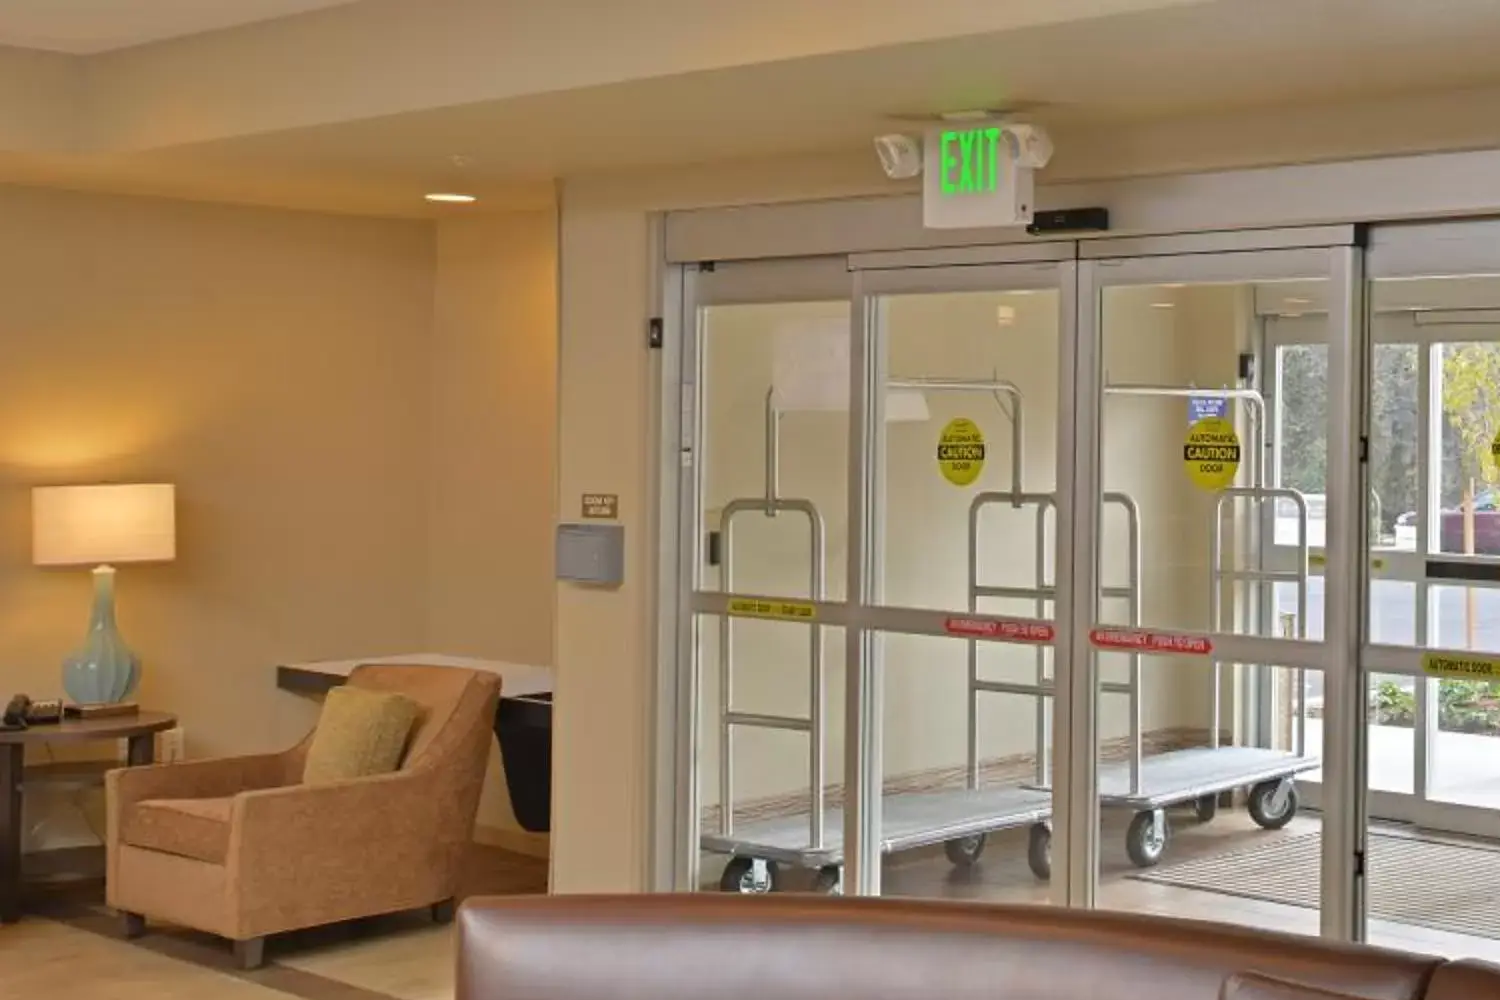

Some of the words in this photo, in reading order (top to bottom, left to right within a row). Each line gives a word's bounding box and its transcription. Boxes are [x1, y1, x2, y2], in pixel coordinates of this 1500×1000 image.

[940, 127, 1001, 194] EXIT
[1190, 434, 1238, 443] AUTOMATIC
[940, 446, 984, 459] CAUTION
[1187, 446, 1237, 460] CAUTION
[1200, 464, 1223, 473] DOOR
[1429, 659, 1470, 672] AUTOMATIC
[1472, 661, 1493, 674] DOOR
